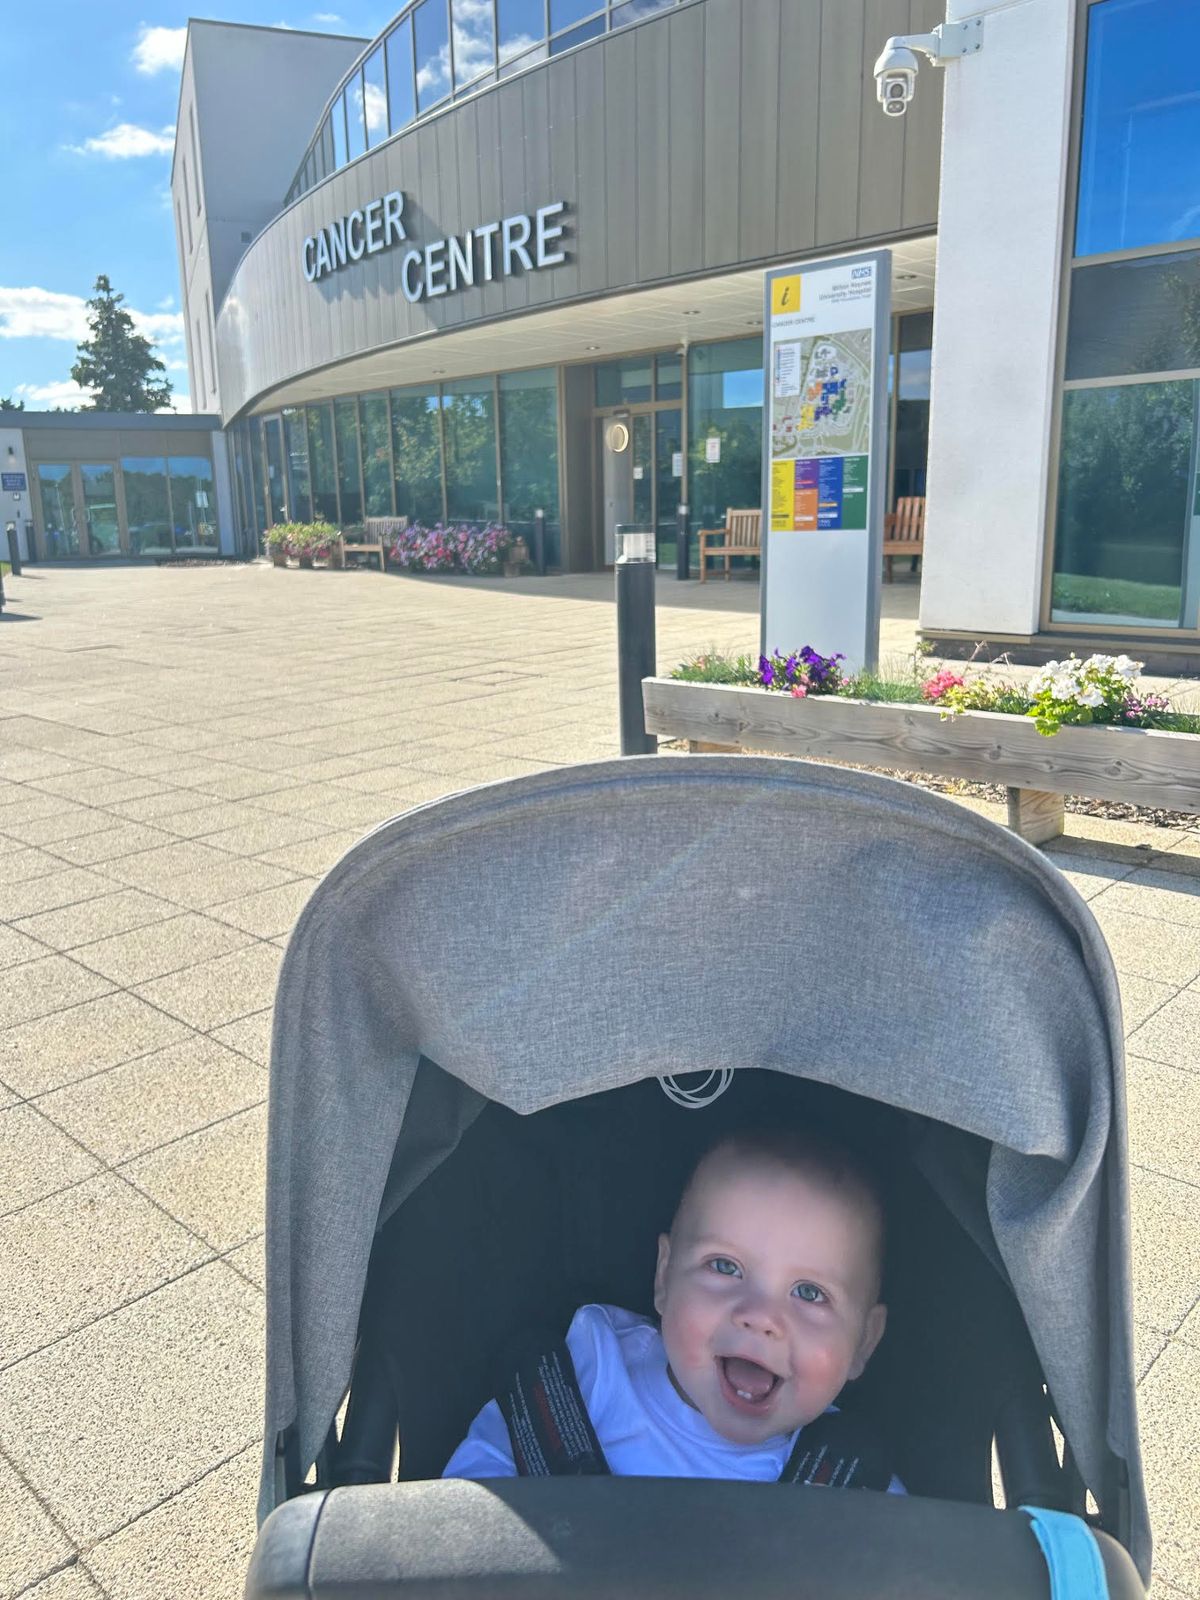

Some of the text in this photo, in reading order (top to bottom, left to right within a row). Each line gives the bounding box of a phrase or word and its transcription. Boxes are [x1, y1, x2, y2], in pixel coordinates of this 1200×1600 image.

[301, 190, 407, 283] CANCER
[401, 201, 566, 304] CENTRE
[819, 291, 847, 301] University
[848, 287, 872, 296] Hospital
[852, 267, 871, 278] NHS
